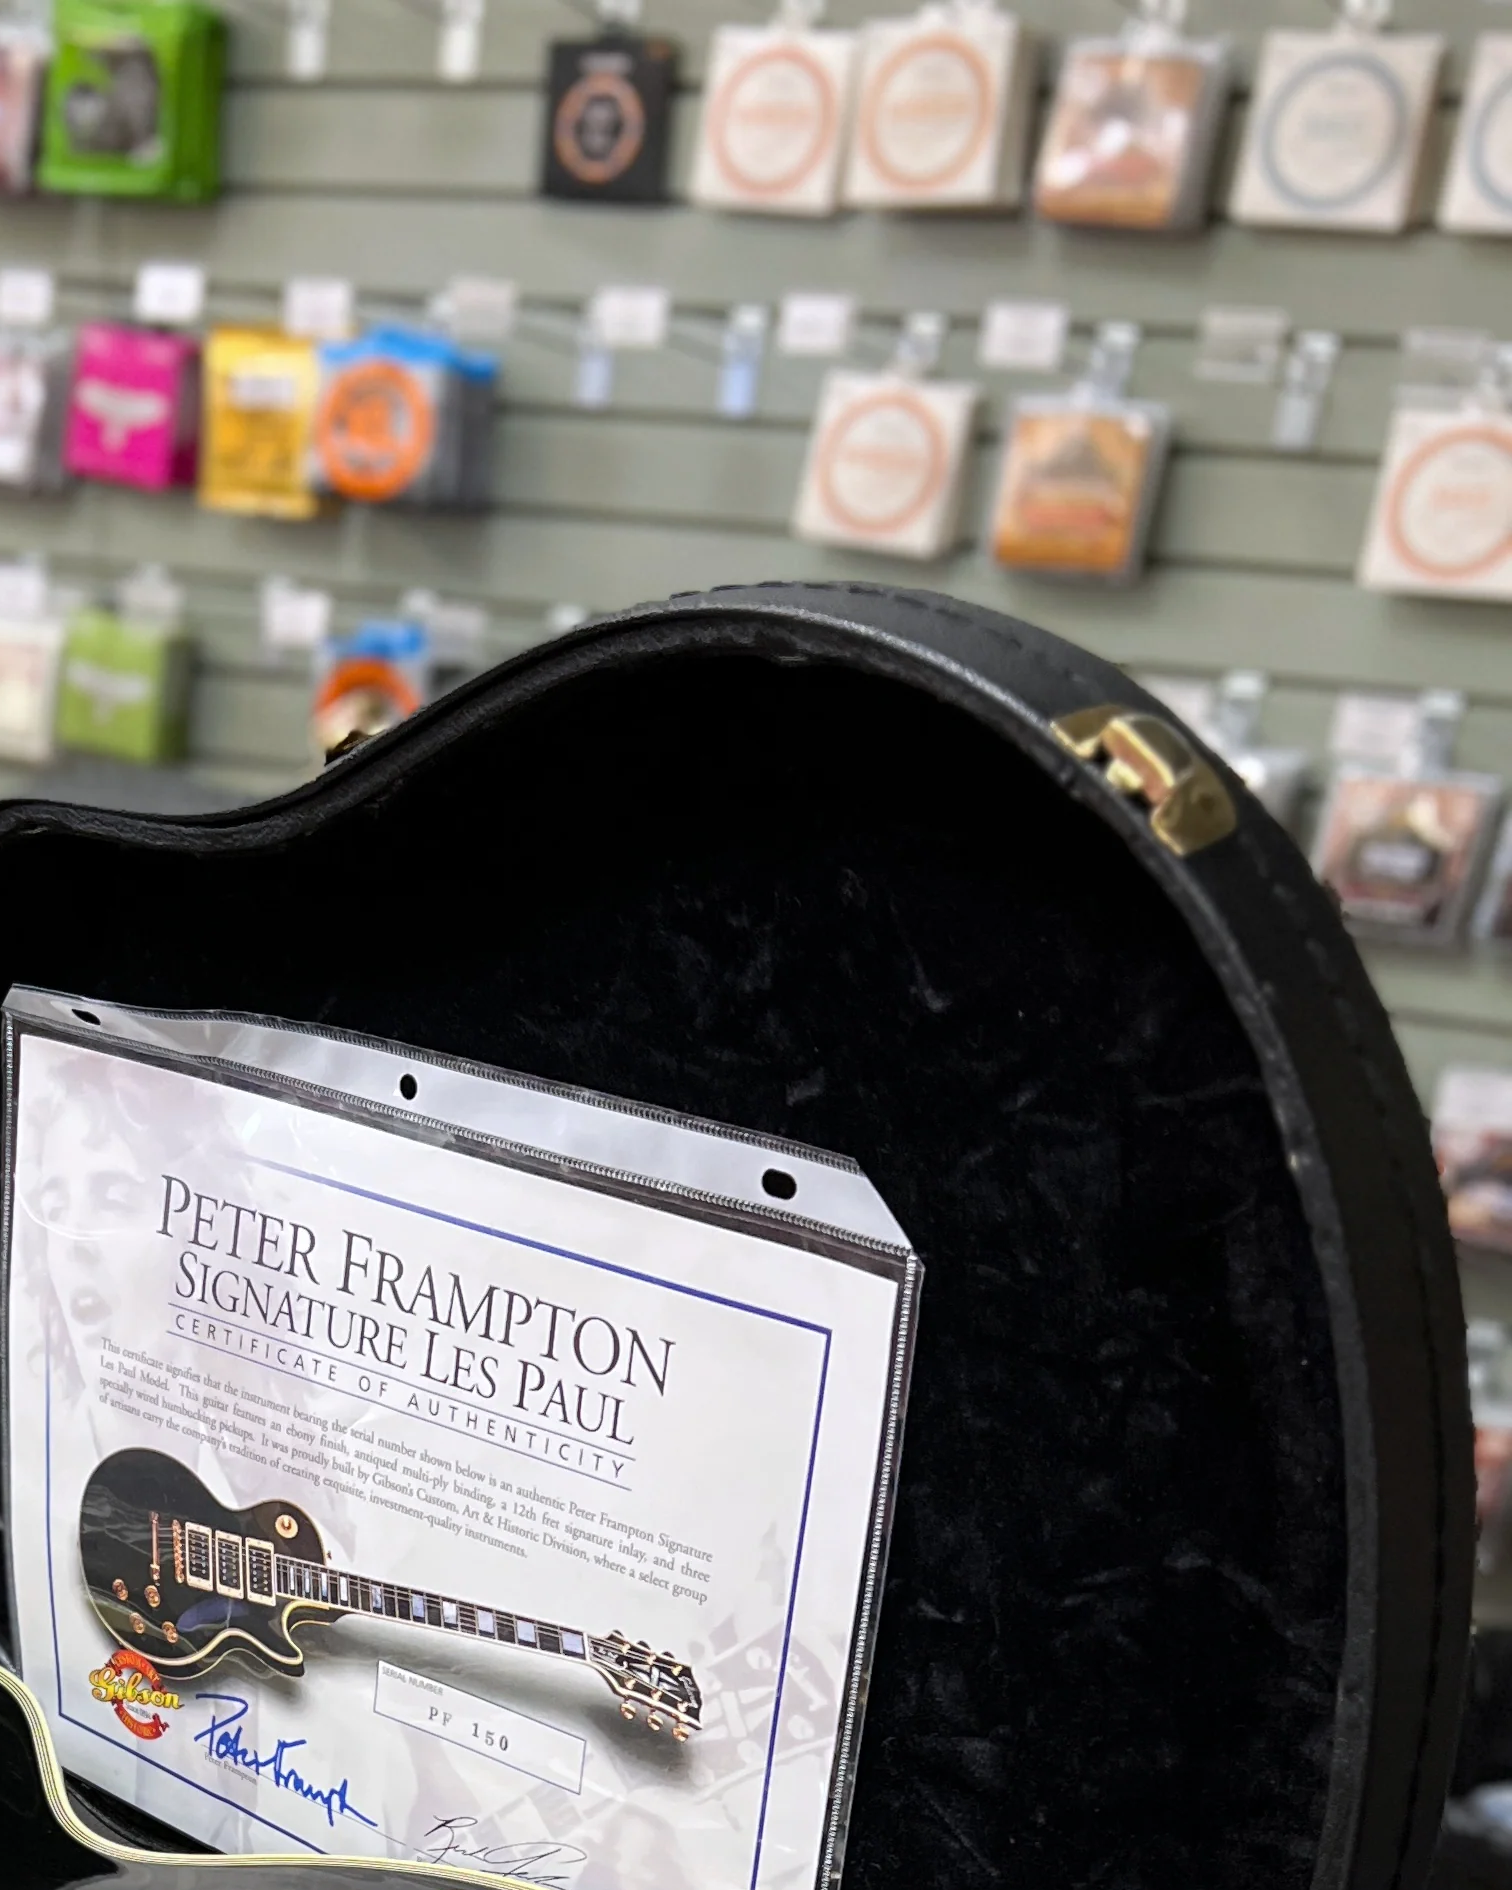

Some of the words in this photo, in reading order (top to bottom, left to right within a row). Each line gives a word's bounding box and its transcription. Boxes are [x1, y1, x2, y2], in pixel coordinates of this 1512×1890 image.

[156, 1174, 320, 1285] PETER
[337, 1229, 676, 1397] FRAMPTON
[175, 1250, 408, 1369] SIGNATURE
[421, 1328, 499, 1399] LES
[513, 1359, 635, 1445] PAUL
[98, 1391, 109, 1404] of
[109, 1398, 141, 1417] artisans
[141, 1411, 164, 1428] carry
[165, 1415, 180, 1432] the
[180, 1425, 227, 1451] company's
[227, 1441, 267, 1465] tradition
[268, 1456, 282, 1469] of
[281, 1458, 320, 1487] creating
[321, 1476, 366, 1501] exquisite,
[369, 1489, 462, 1535] investment-quality
[464, 1523, 527, 1558] instruments.
[98, 1376, 134, 1399] specially
[135, 1389, 160, 1406] wired
[160, 1395, 217, 1431] humbucking
[217, 1419, 255, 1443] pickups.
[260, 1431, 269, 1447] It
[270, 1438, 289, 1454] was
[290, 1446, 330, 1470] proudly
[330, 1455, 355, 1476] built
[356, 1463, 370, 1485] by
[371, 1470, 414, 1497] Gibson's
[415, 1486, 459, 1517] Custom,
[461, 1503, 480, 1521] Art
[481, 1510, 494, 1527] &
[496, 1515, 540, 1542] Historic
[541, 1531, 590, 1563] Division,
[592, 1552, 627, 1575] where
[628, 1567, 636, 1579] a
[637, 1569, 670, 1590] select
[671, 1583, 708, 1606] group
[99, 1354, 114, 1371] Les
[117, 1360, 136, 1379] Paul
[139, 1368, 170, 1391] Model.
[177, 1382, 199, 1402] This
[201, 1395, 229, 1412] guitar
[231, 1401, 266, 1426] features
[269, 1420, 282, 1432] an
[285, 1421, 316, 1446] ebony
[318, 1432, 350, 1457] finish,
[353, 1449, 397, 1472] antiqued
[401, 1465, 449, 1492] multi-ply
[452, 1478, 496, 1509] binding,
[499, 1500, 507, 1511] a
[512, 1500, 537, 1521] 12th
[540, 1510, 560, 1530] fret
[563, 1521, 614, 1549] signature
[617, 1538, 647, 1563] inlay,
[651, 1555, 675, 1571] and
[679, 1560, 711, 1583] three
[100, 1335, 121, 1355] This
[121, 1348, 164, 1370] certificate
[164, 1361, 201, 1383] signifies
[202, 1372, 222, 1390] that
[223, 1380, 238, 1397] the
[239, 1386, 290, 1415] instrument
[292, 1403, 329, 1432] bearing
[330, 1418, 348, 1435] the
[348, 1421, 375, 1444] serial
[376, 1437, 416, 1459] number
[418, 1448, 452, 1472] shown
[454, 1459, 486, 1482] below
[487, 1472, 497, 1488] is
[498, 1480, 513, 1493] an
[515, 1485, 566, 1511] authentic
[567, 1500, 595, 1522] Peter
[598, 1511, 654, 1543] Frampton
[657, 1532, 713, 1562] Signature
[175, 1313, 338, 1382] CERTIFICATE
[358, 1375, 388, 1397] OF
[407, 1393, 624, 1478] AUTHENTICITY
[89, 1667, 185, 1710] Gibson
[428, 1706, 452, 1726] PF
[471, 1722, 509, 1751] 150
